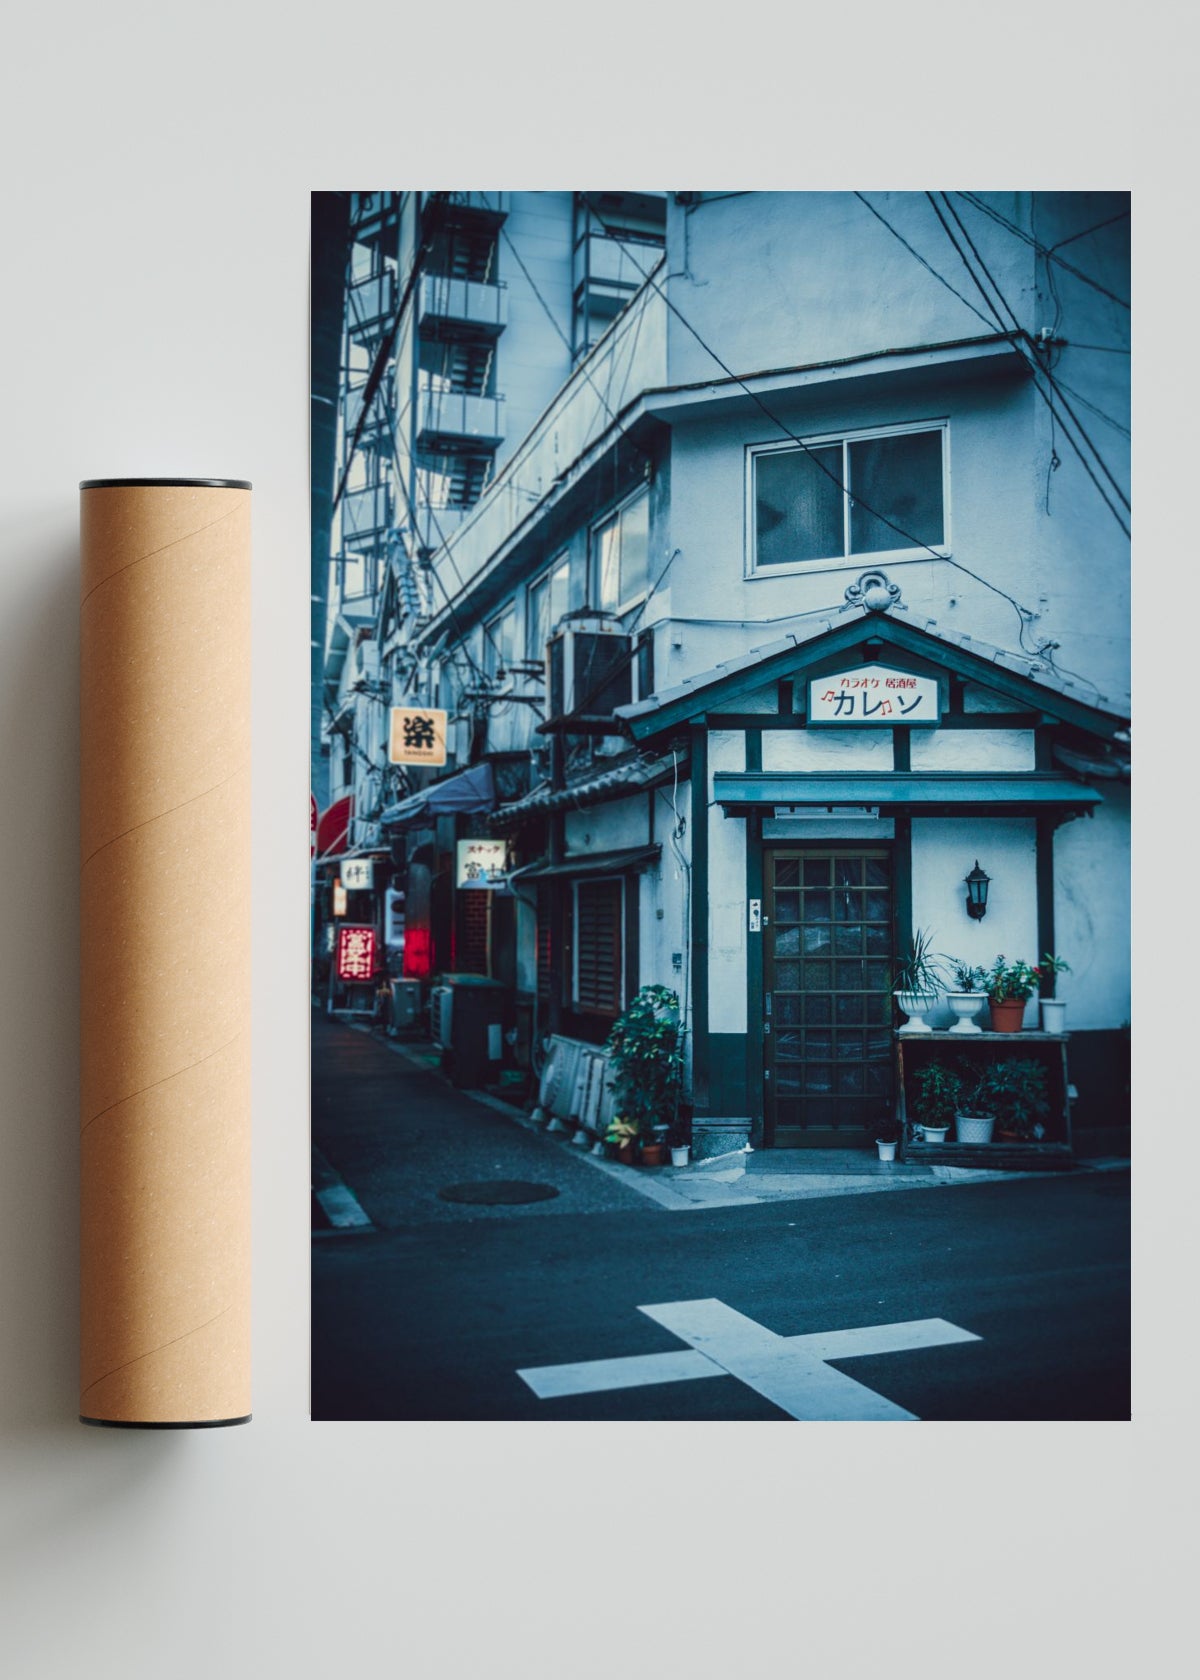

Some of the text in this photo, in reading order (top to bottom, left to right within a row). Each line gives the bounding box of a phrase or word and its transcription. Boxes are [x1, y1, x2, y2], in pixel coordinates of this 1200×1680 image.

[840, 678, 918, 689] カラオケ 居酒屋
[833, 690, 923, 716] カレン
[403, 716, 435, 749] 楽
[467, 845, 500, 854] スナック
[464, 861, 503, 879] 富士
